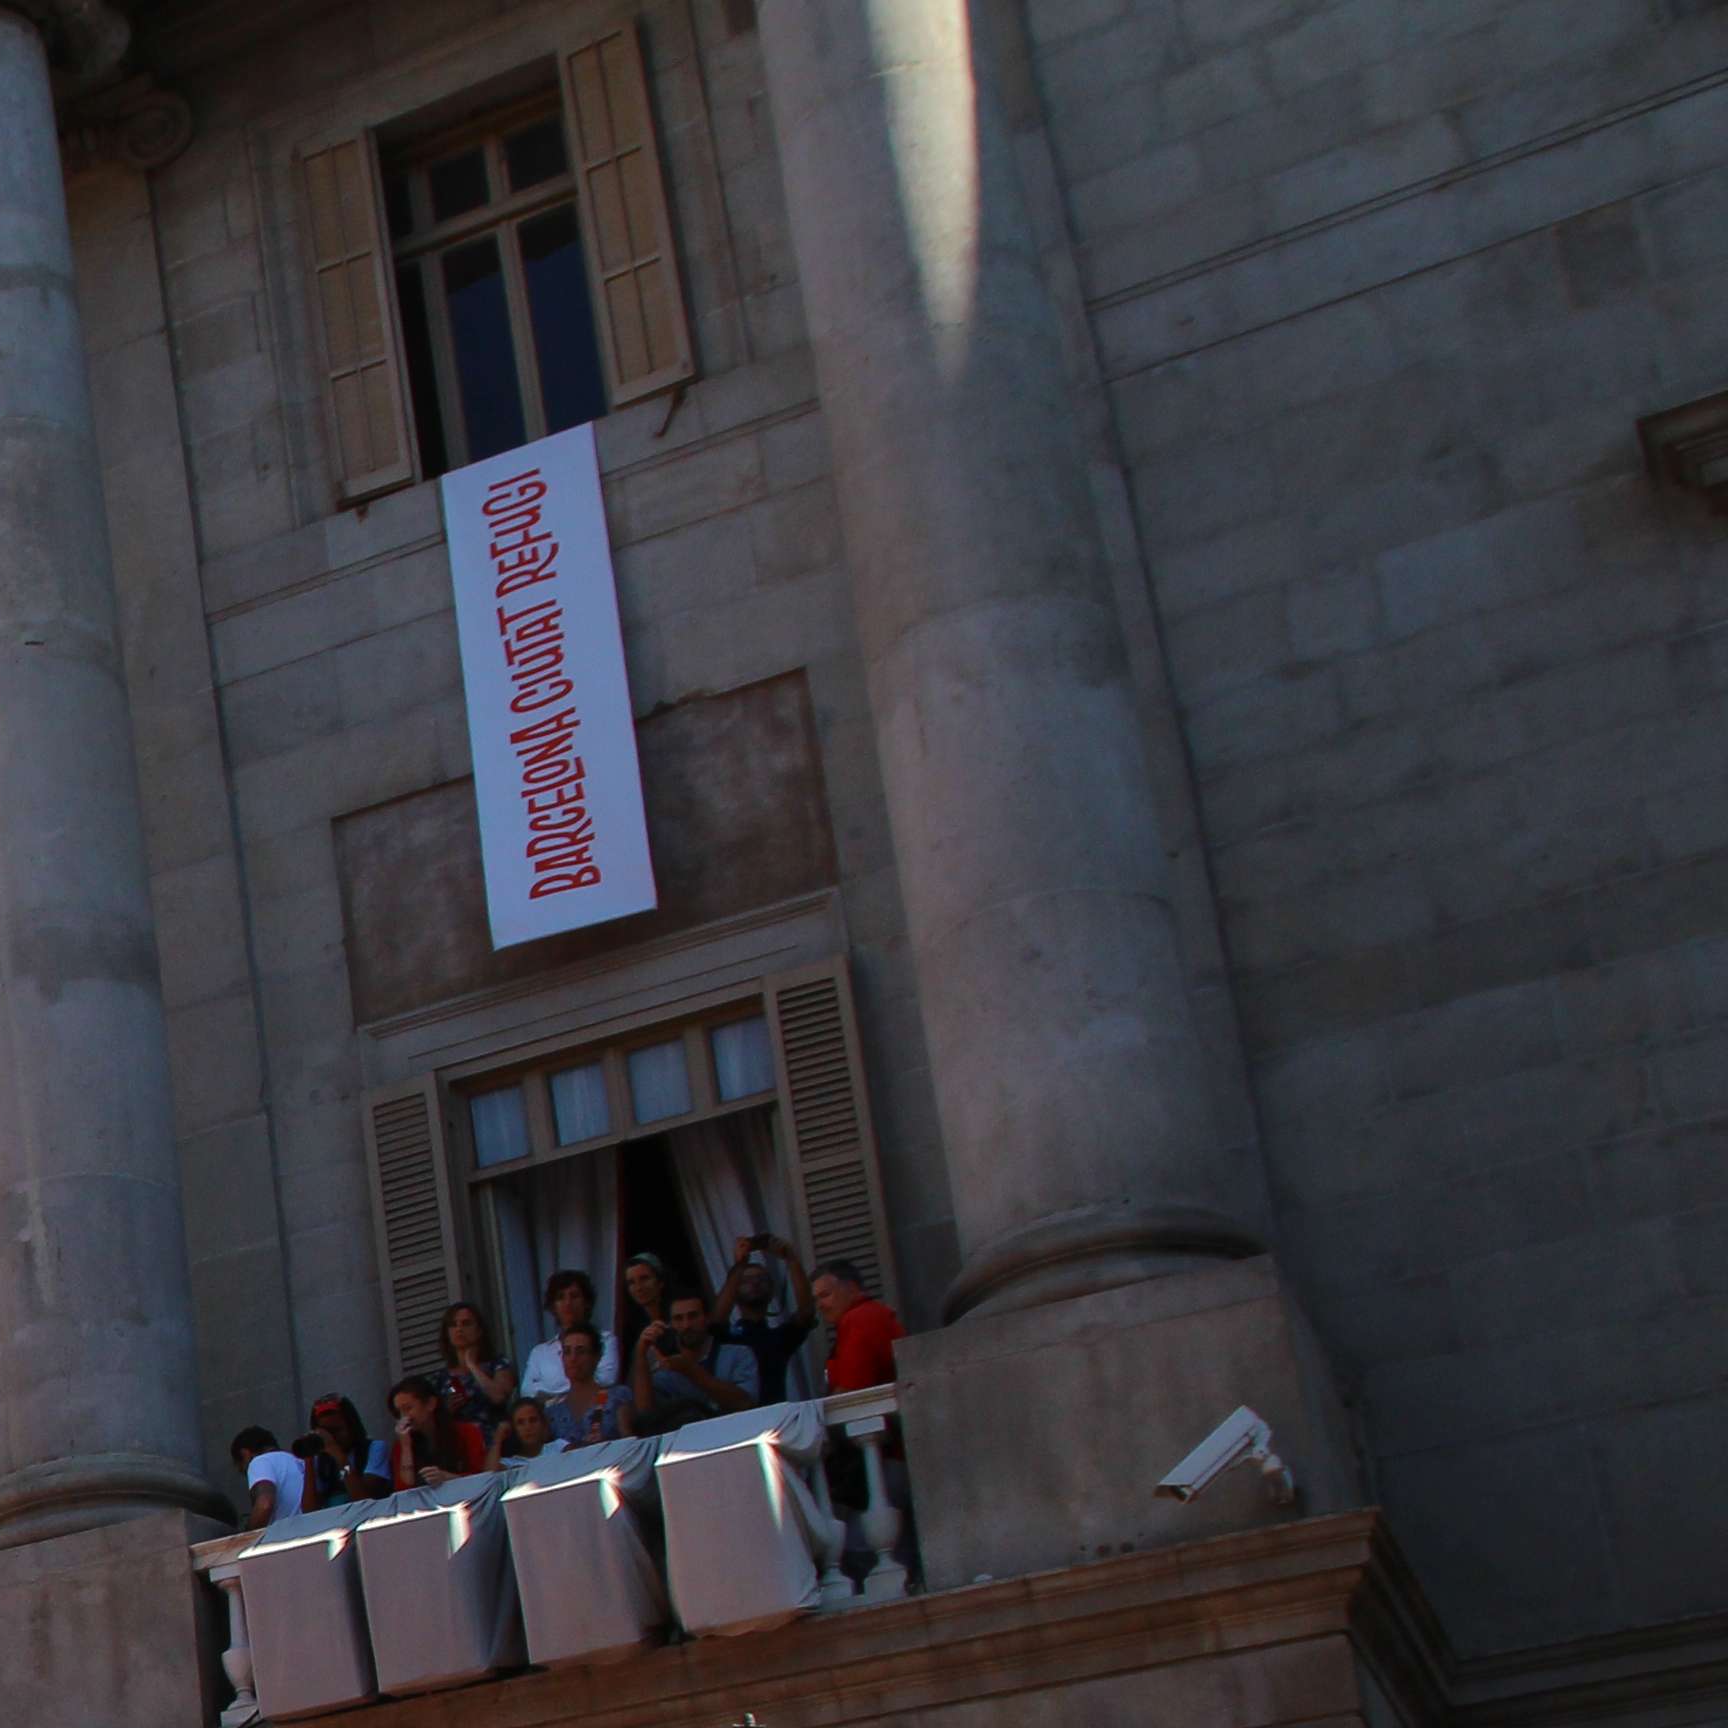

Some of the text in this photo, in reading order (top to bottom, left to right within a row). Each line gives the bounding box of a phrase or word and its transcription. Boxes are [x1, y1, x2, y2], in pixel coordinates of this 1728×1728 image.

[481, 468, 602, 900] BARCELONA CIUTAT REFUGI
